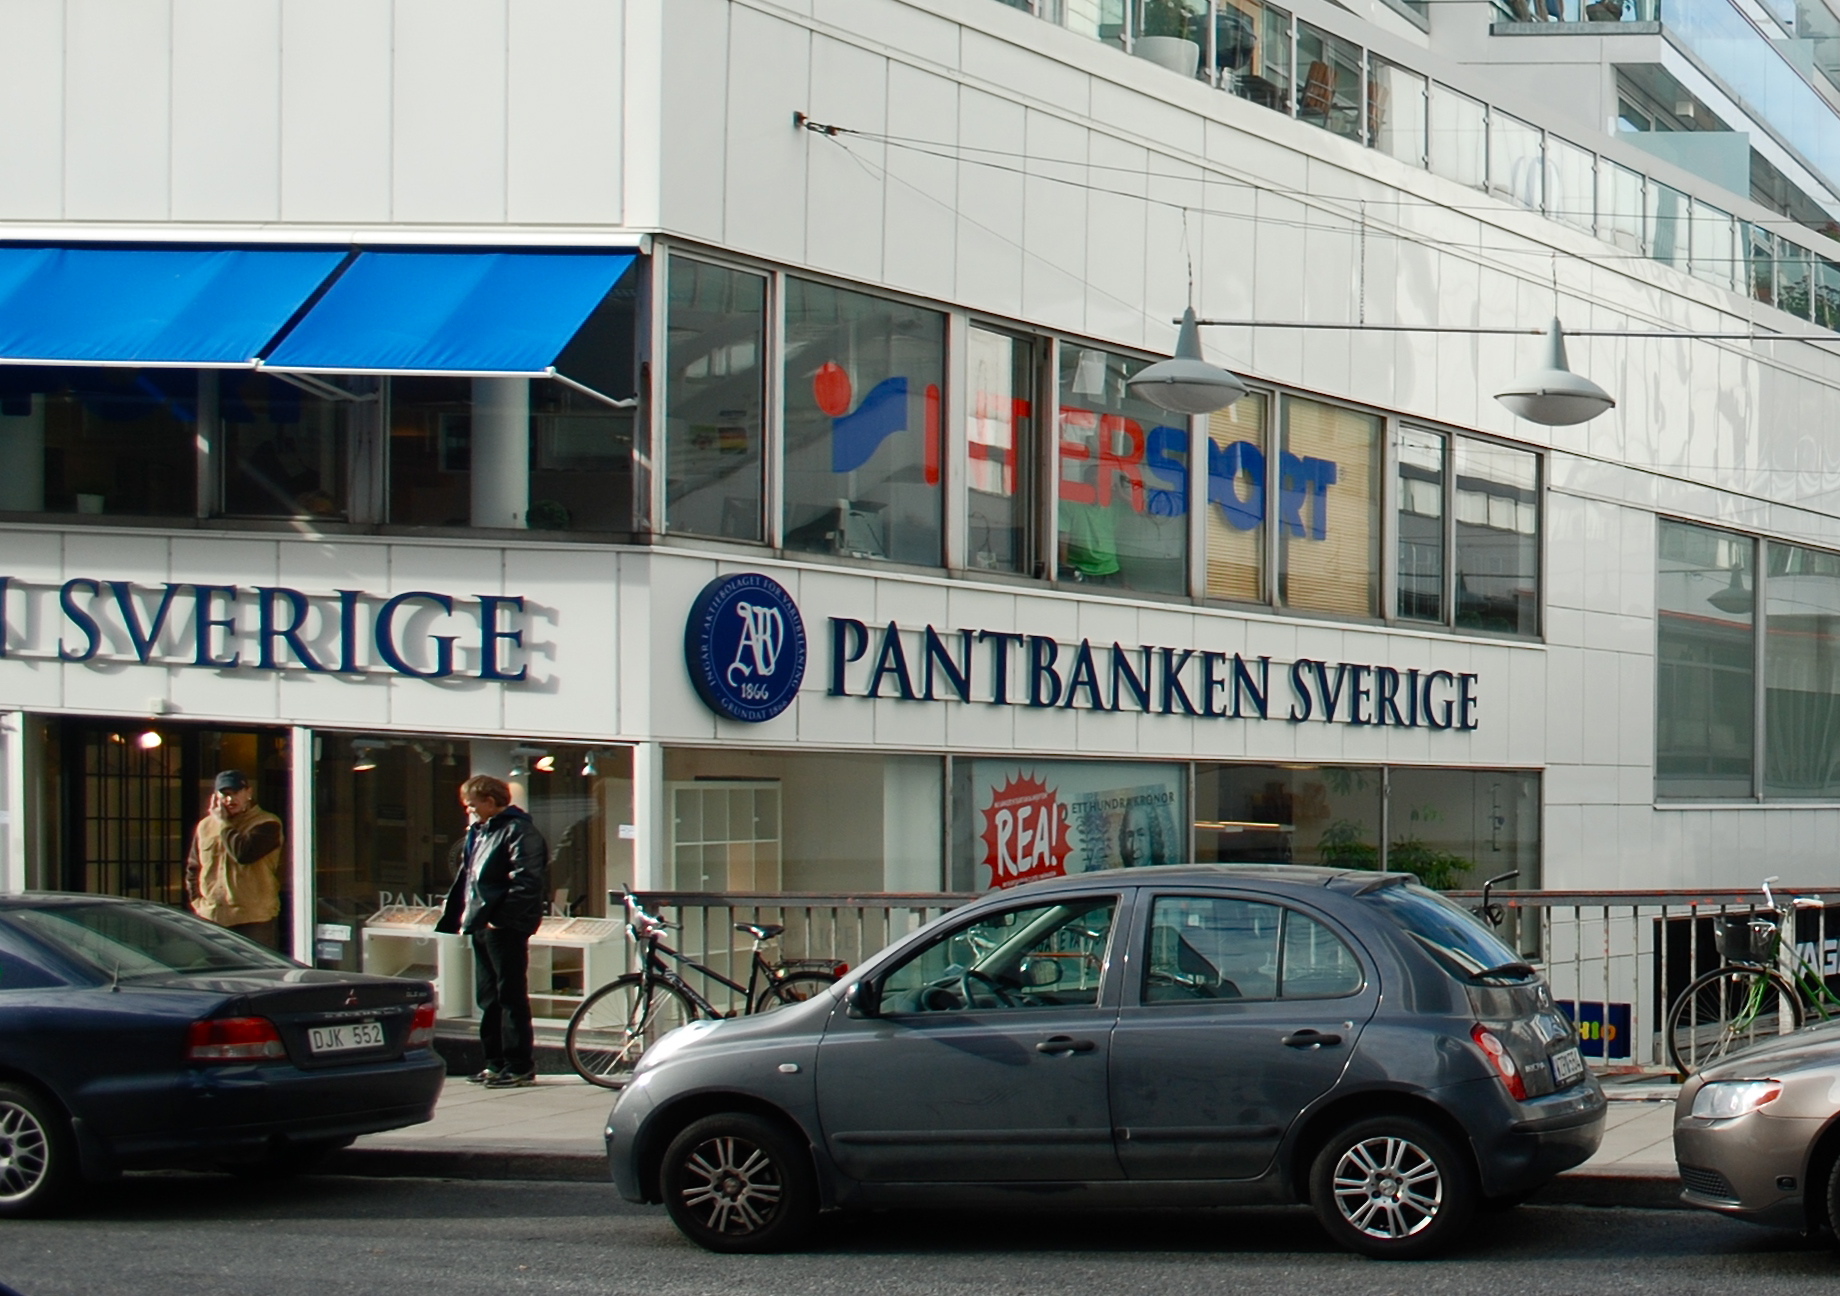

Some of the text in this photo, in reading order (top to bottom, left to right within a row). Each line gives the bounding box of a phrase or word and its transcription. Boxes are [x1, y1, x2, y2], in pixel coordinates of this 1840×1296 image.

[59, 578, 527, 681] SVERIGE
[741, 682, 769, 700] 1866
[827, 618, 1270, 718] PANTBANKEN
[1289, 659, 1480, 730] SVERIGE
[995, 802, 1058, 876] REA!
[313, 1025, 381, 1050] DJK 552
